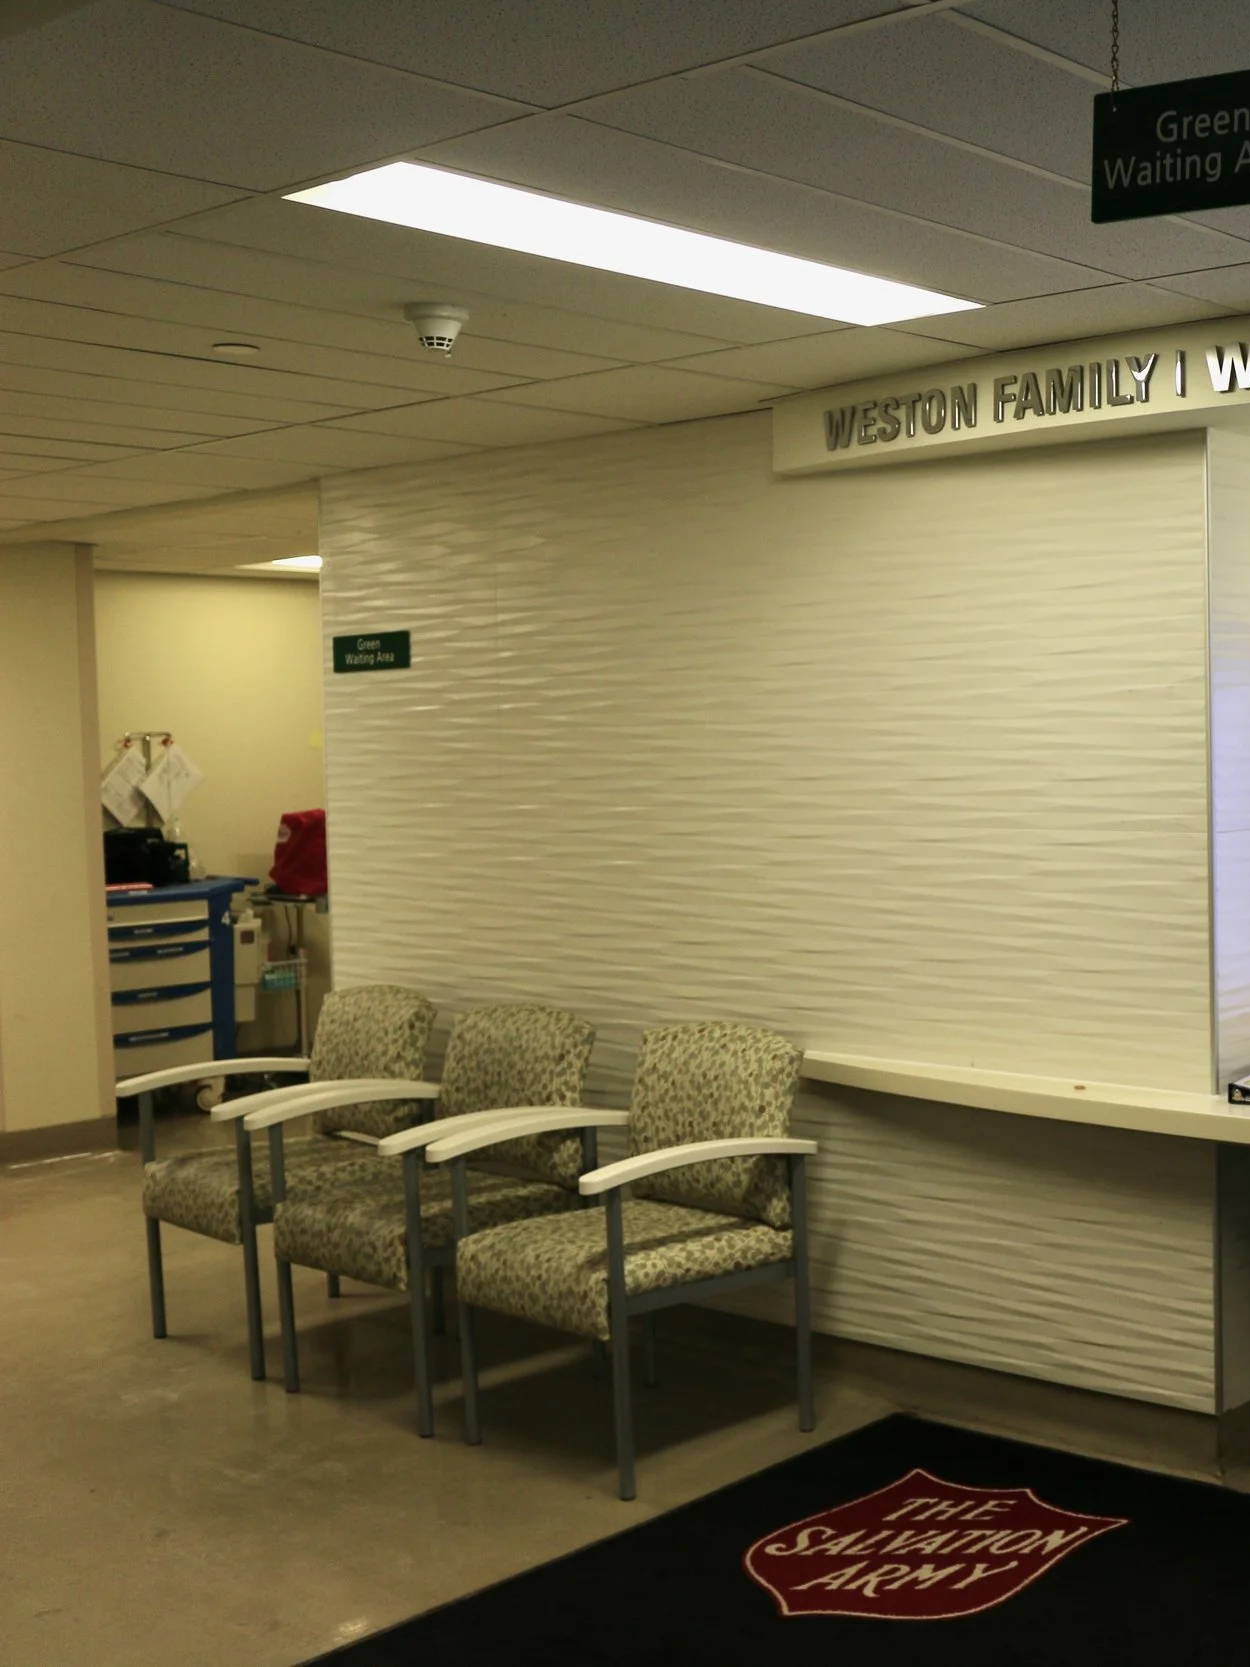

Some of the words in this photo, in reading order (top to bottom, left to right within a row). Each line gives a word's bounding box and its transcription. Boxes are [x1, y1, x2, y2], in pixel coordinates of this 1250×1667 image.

[1156, 107, 1250, 143] Green
[1104, 148, 1222, 190] Waiting
[824, 382, 977, 452] WESTON
[993, 352, 1159, 424] FAMILY
[345, 652, 375, 666] Waiting
[376, 651, 394, 663] Area
[357, 638, 381, 651] Green
[881, 1498, 1018, 1521] THE
[764, 1525, 1089, 1556] SALVATION
[788, 1560, 1019, 1598] ARMY
